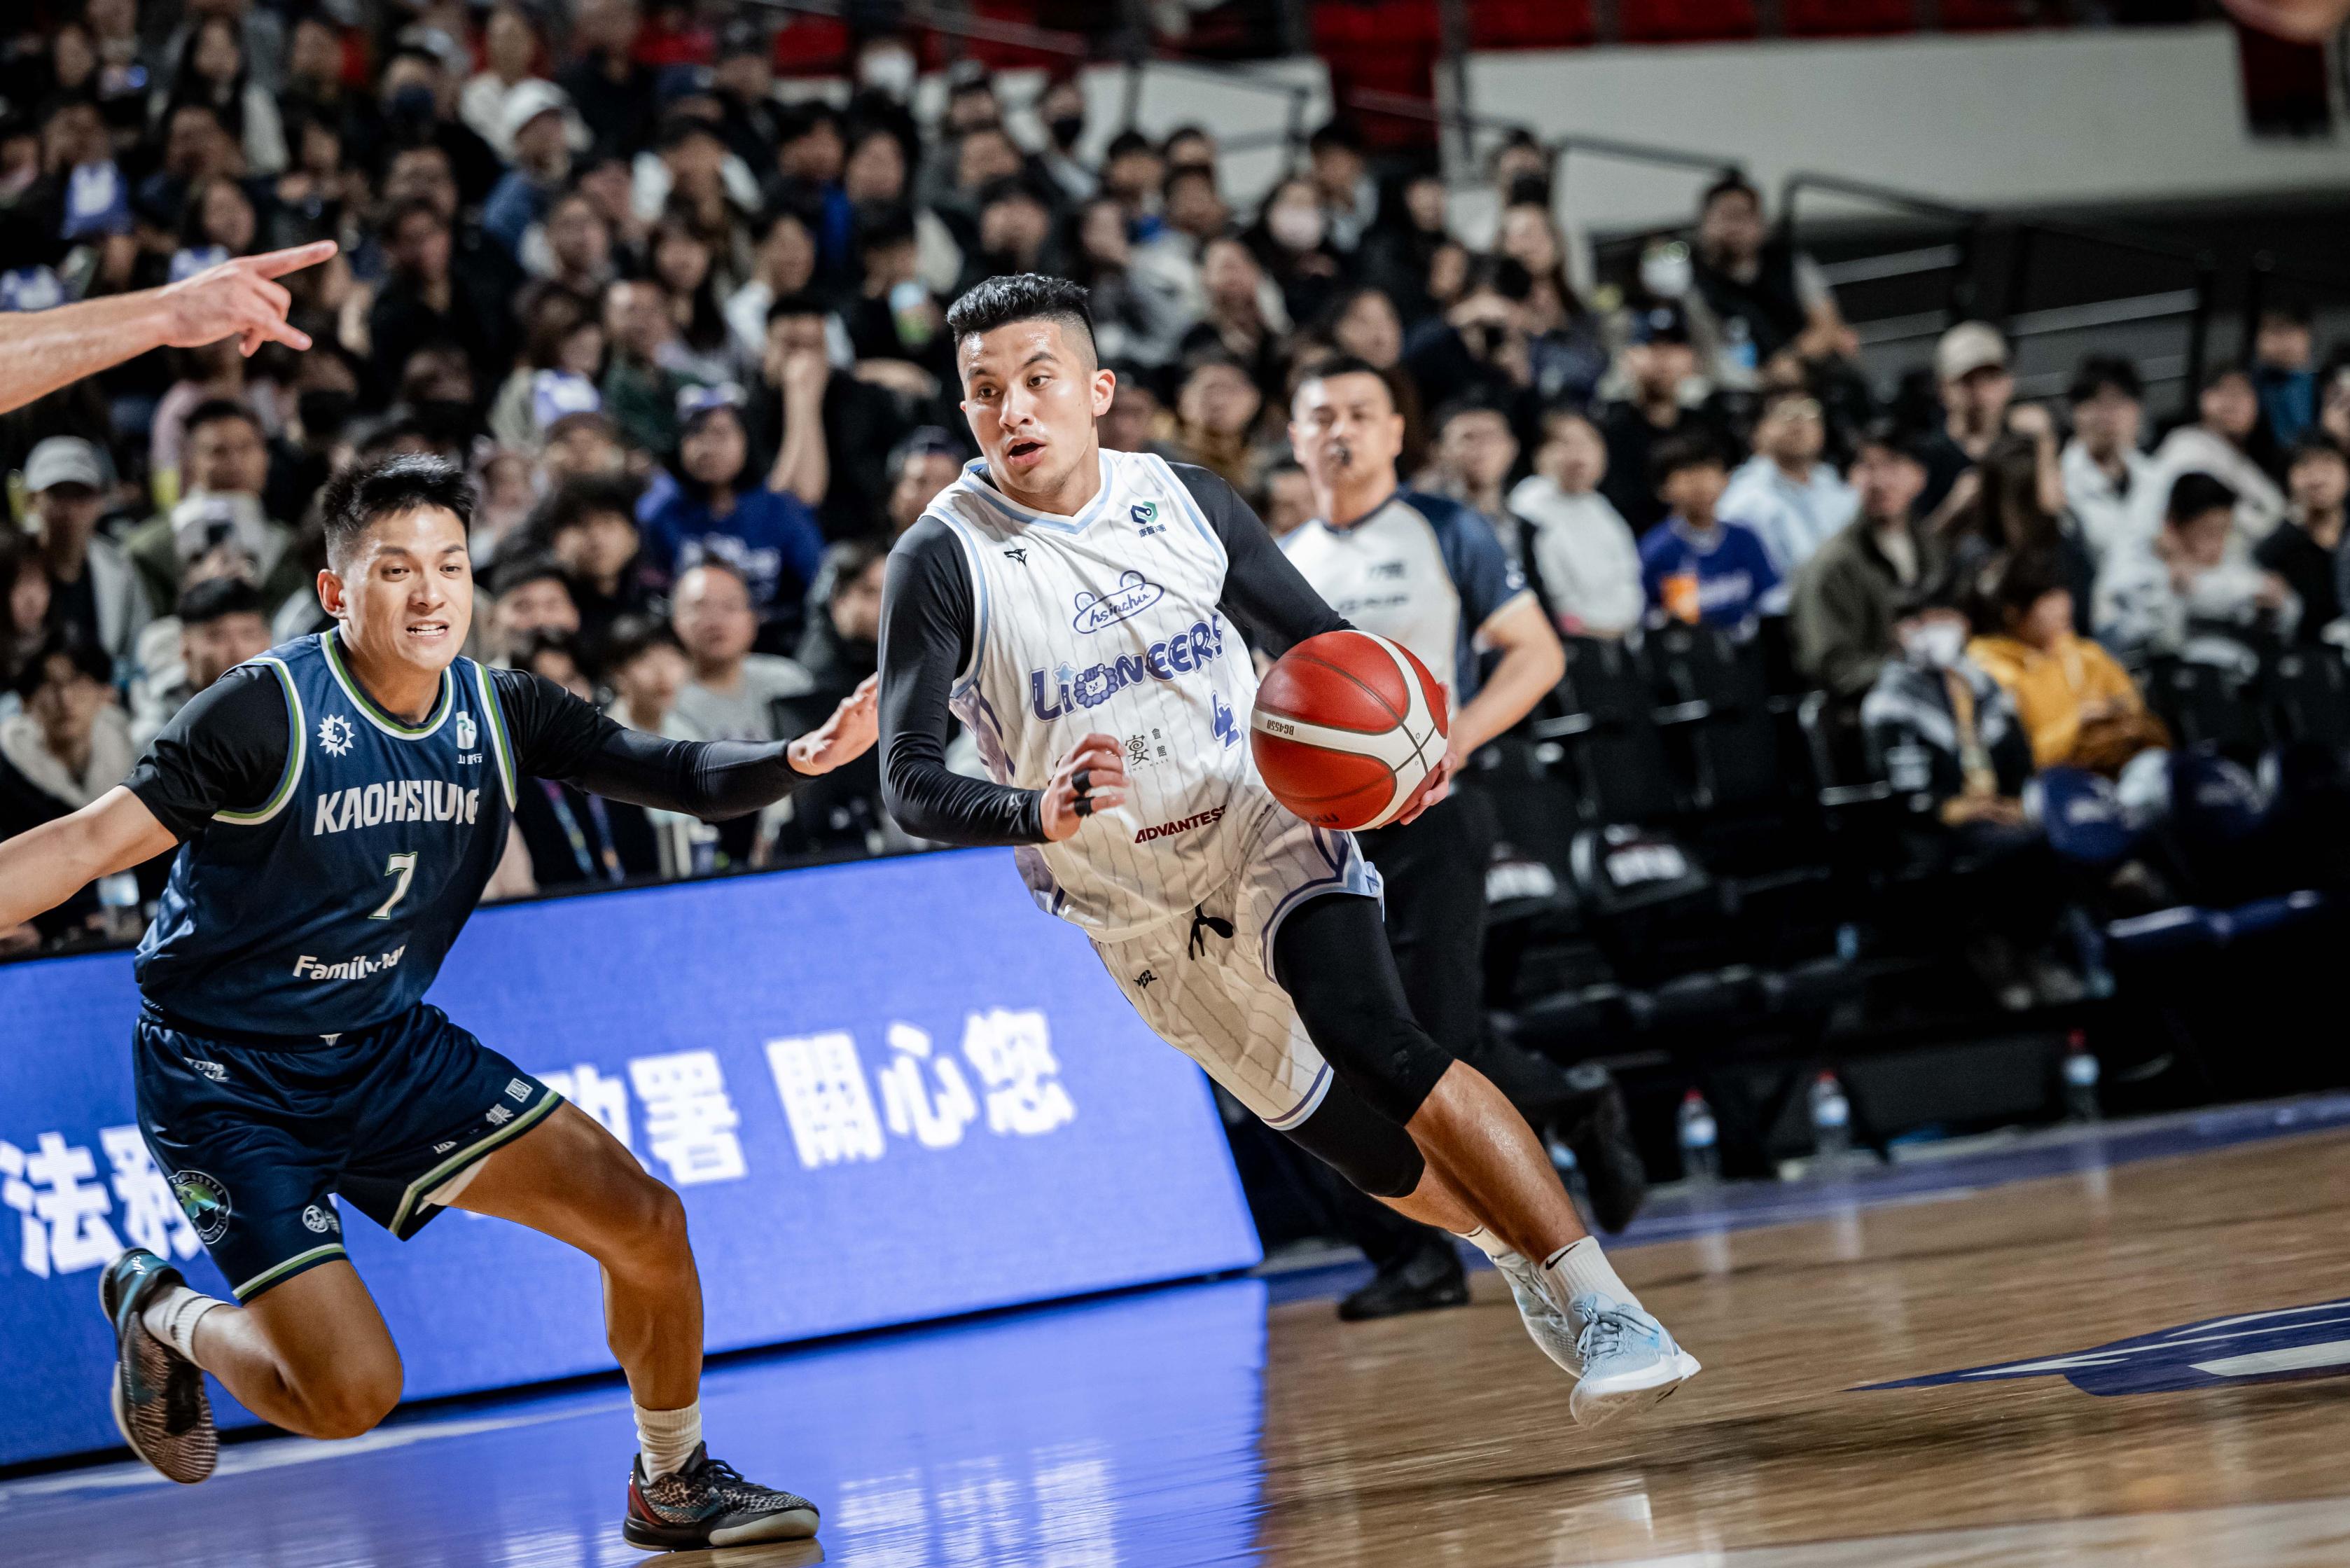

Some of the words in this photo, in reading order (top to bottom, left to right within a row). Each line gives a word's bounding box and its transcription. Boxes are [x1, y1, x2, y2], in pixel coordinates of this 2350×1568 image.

[1211, 691, 1244, 750] 4
[1267, 719, 1295, 736] BG4550
[1134, 804, 1227, 844] ADVANTEST
[367, 851, 418, 920] 7
[764, 1006, 1077, 1170] 關心您
